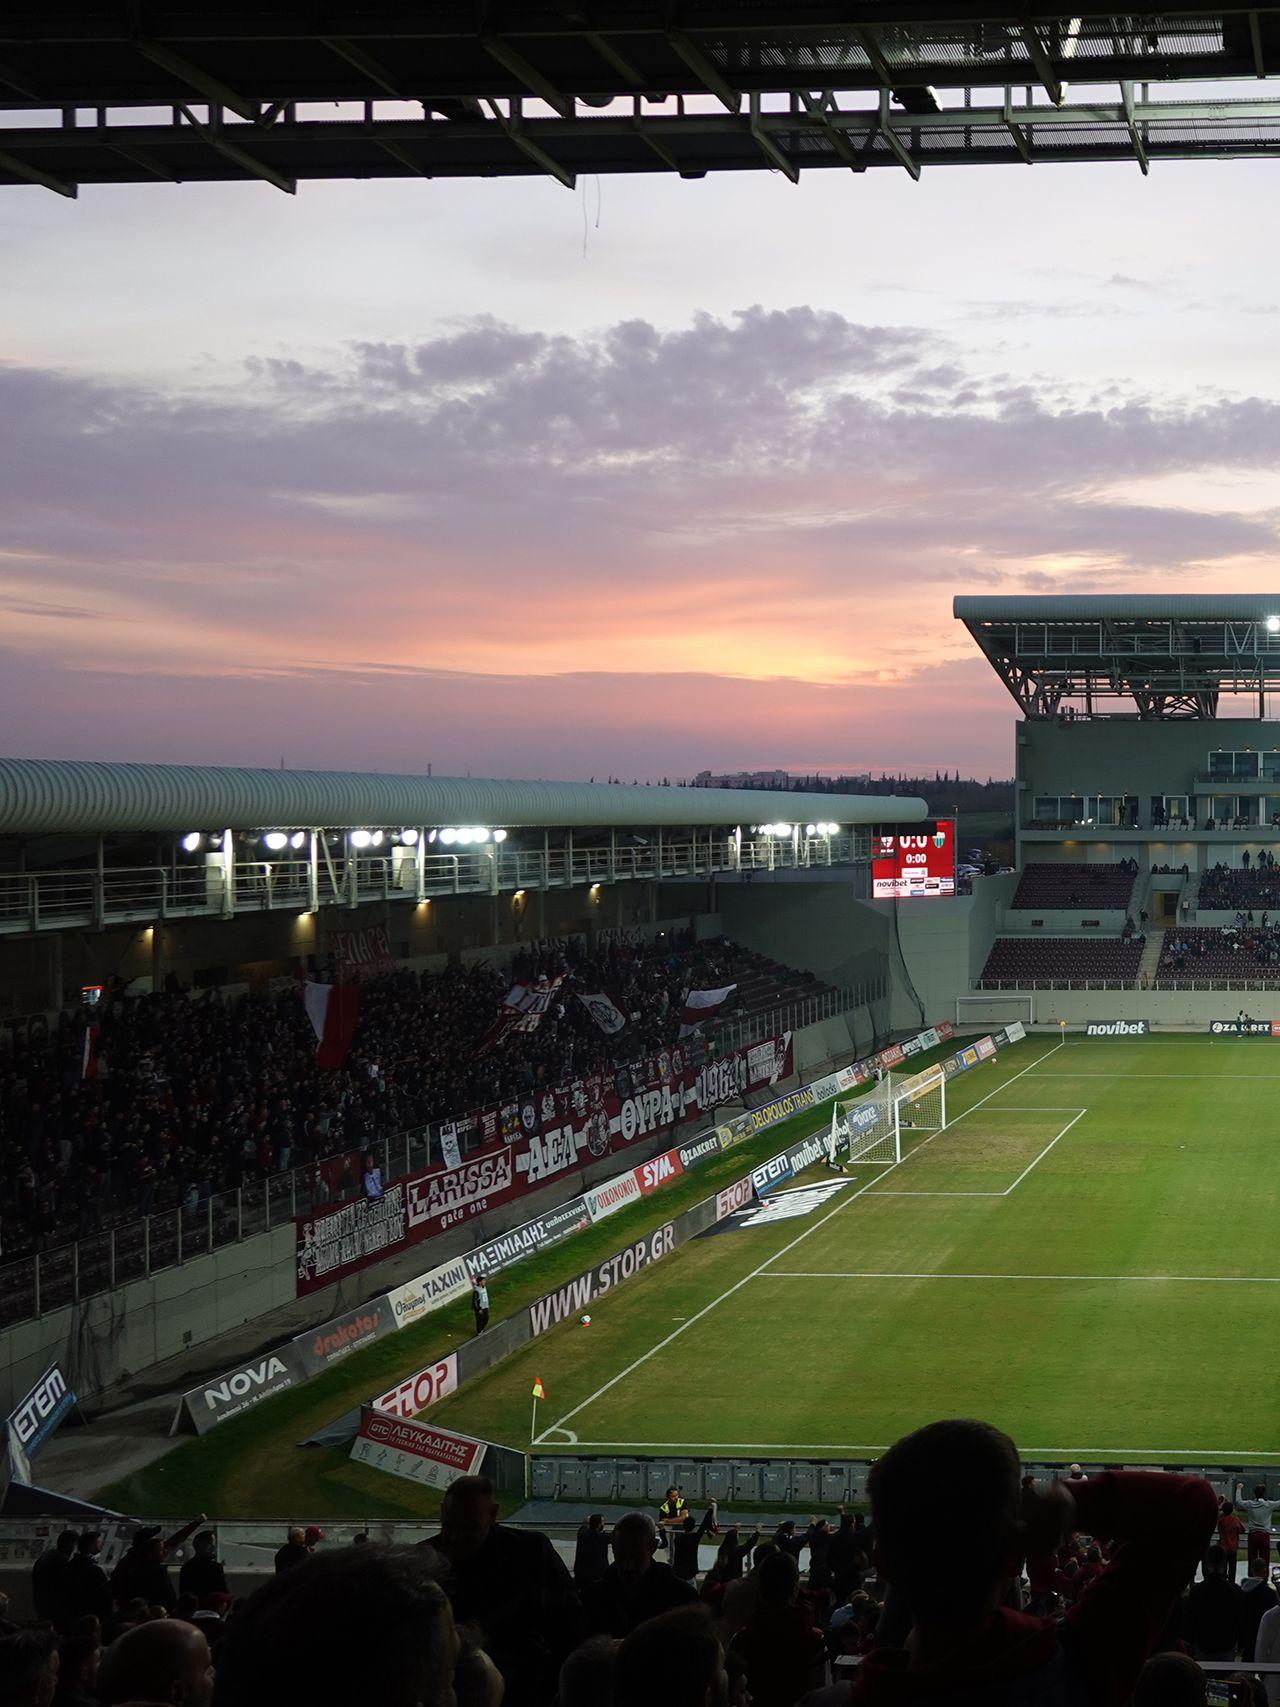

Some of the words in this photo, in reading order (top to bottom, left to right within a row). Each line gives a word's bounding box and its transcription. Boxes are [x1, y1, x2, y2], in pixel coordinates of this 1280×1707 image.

[905, 853, 927, 864] 0:00
[876, 879, 908, 887] novibet
[1087, 1021, 1145, 1035] novibet
[751, 1097, 794, 1129] DELOPOULOS
[793, 1088, 814, 1110] TRANS
[687, 1136, 719, 1161] ZAKCRET
[790, 1136, 825, 1173] novibet
[409, 1155, 510, 1217] LARISSA
[642, 1153, 676, 1187] SYM
[752, 1154, 790, 1188] ETEM
[440, 1208, 464, 1229] gate
[470, 1199, 488, 1213] one
[465, 1221, 548, 1276] ΜΑΞΙΜΙΑΔΗΣ
[529, 1224, 676, 1337] WWW.STOP.GR
[204, 1356, 289, 1410] NOVA
[13, 1368, 67, 1443] ETEM
[369, 1423, 390, 1436] GTC
[391, 1425, 470, 1457] ΛΕΥΚΑΔΙΤΗΣ
